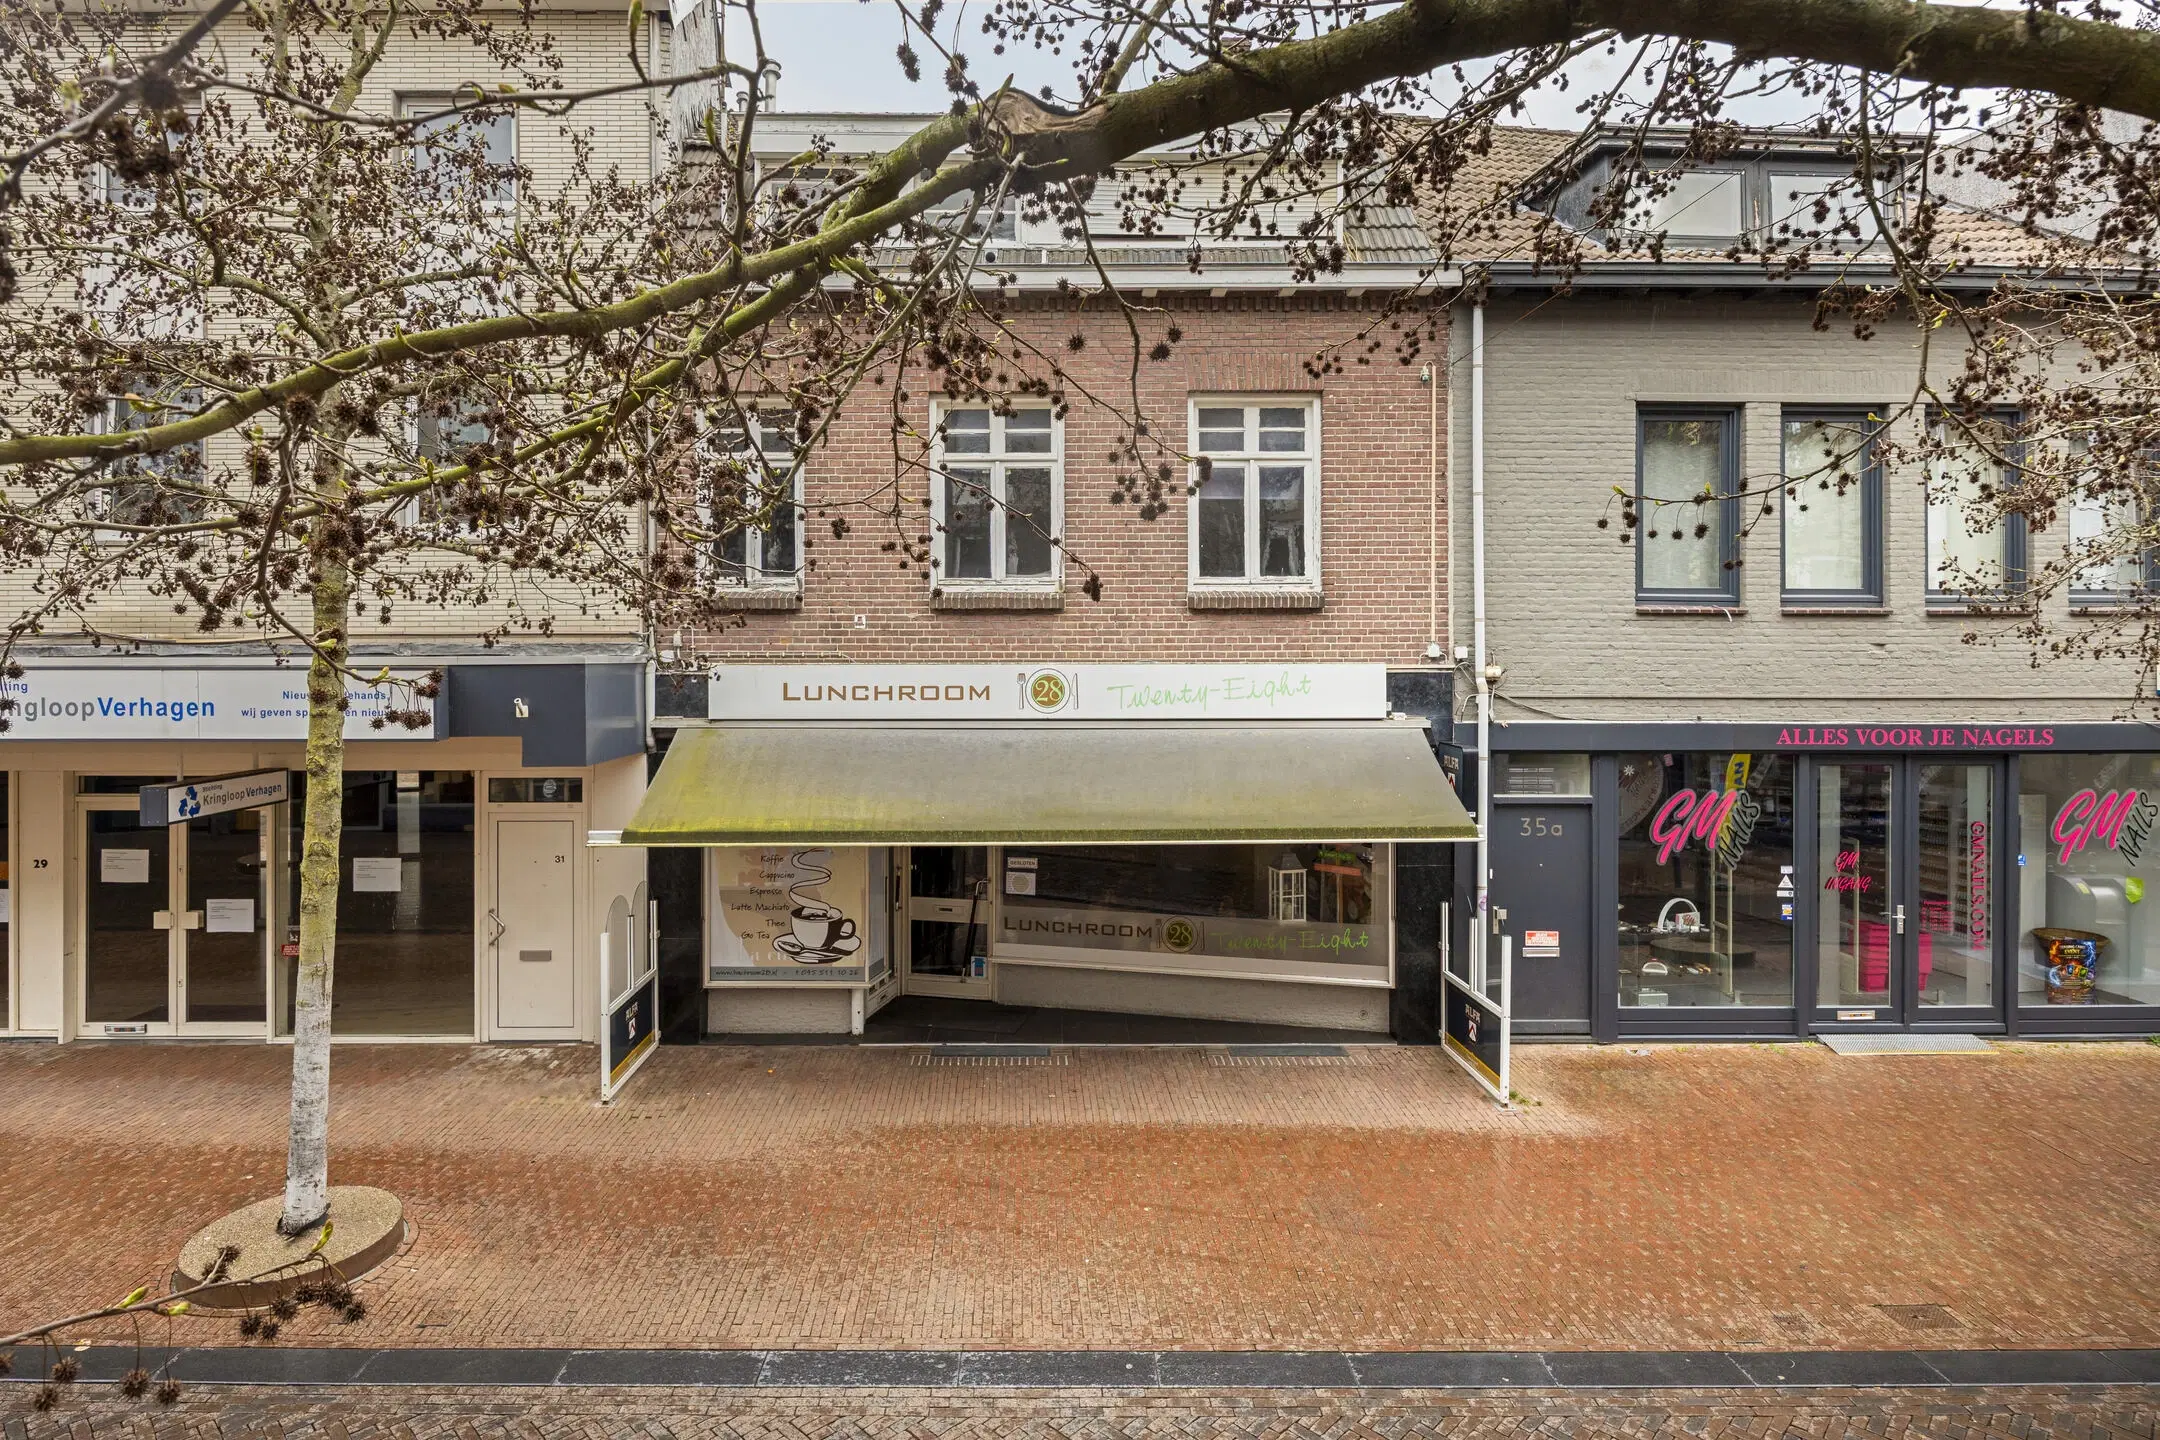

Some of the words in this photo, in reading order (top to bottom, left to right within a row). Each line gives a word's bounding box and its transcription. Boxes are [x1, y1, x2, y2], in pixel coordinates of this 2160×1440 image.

[782, 682, 991, 702] LUNCHROOM
[1035, 679, 1063, 702] 28
[1106, 671, 1312, 712] Twenty-Eight
[241, 709, 257, 718] wij
[260, 710, 292, 719] geven
[1776, 728, 1848, 745] ALLES
[1856, 728, 1924, 746] VOOR
[1928, 728, 1955, 746] JE
[1962, 728, 2055, 746] NAGELS
[1520, 817, 1563, 837] 35a
[1650, 788, 1738, 866] GM
[1718, 791, 1761, 869] NAILS
[2053, 790, 2137, 864] GM
[2118, 791, 2159, 867] NAILS
[33, 859, 48, 869] 29
[554, 855, 565, 864] 31
[760, 854, 784, 865] Koffie
[749, 887, 783, 898] Espresso
[1825, 876, 1872, 893] INGANG
[765, 919, 786, 928] Thee
[1004, 916, 1153, 938] LUNCHROOM
[1169, 924, 1192, 943] 28
[1209, 928, 1369, 955] Twenty-Eight
